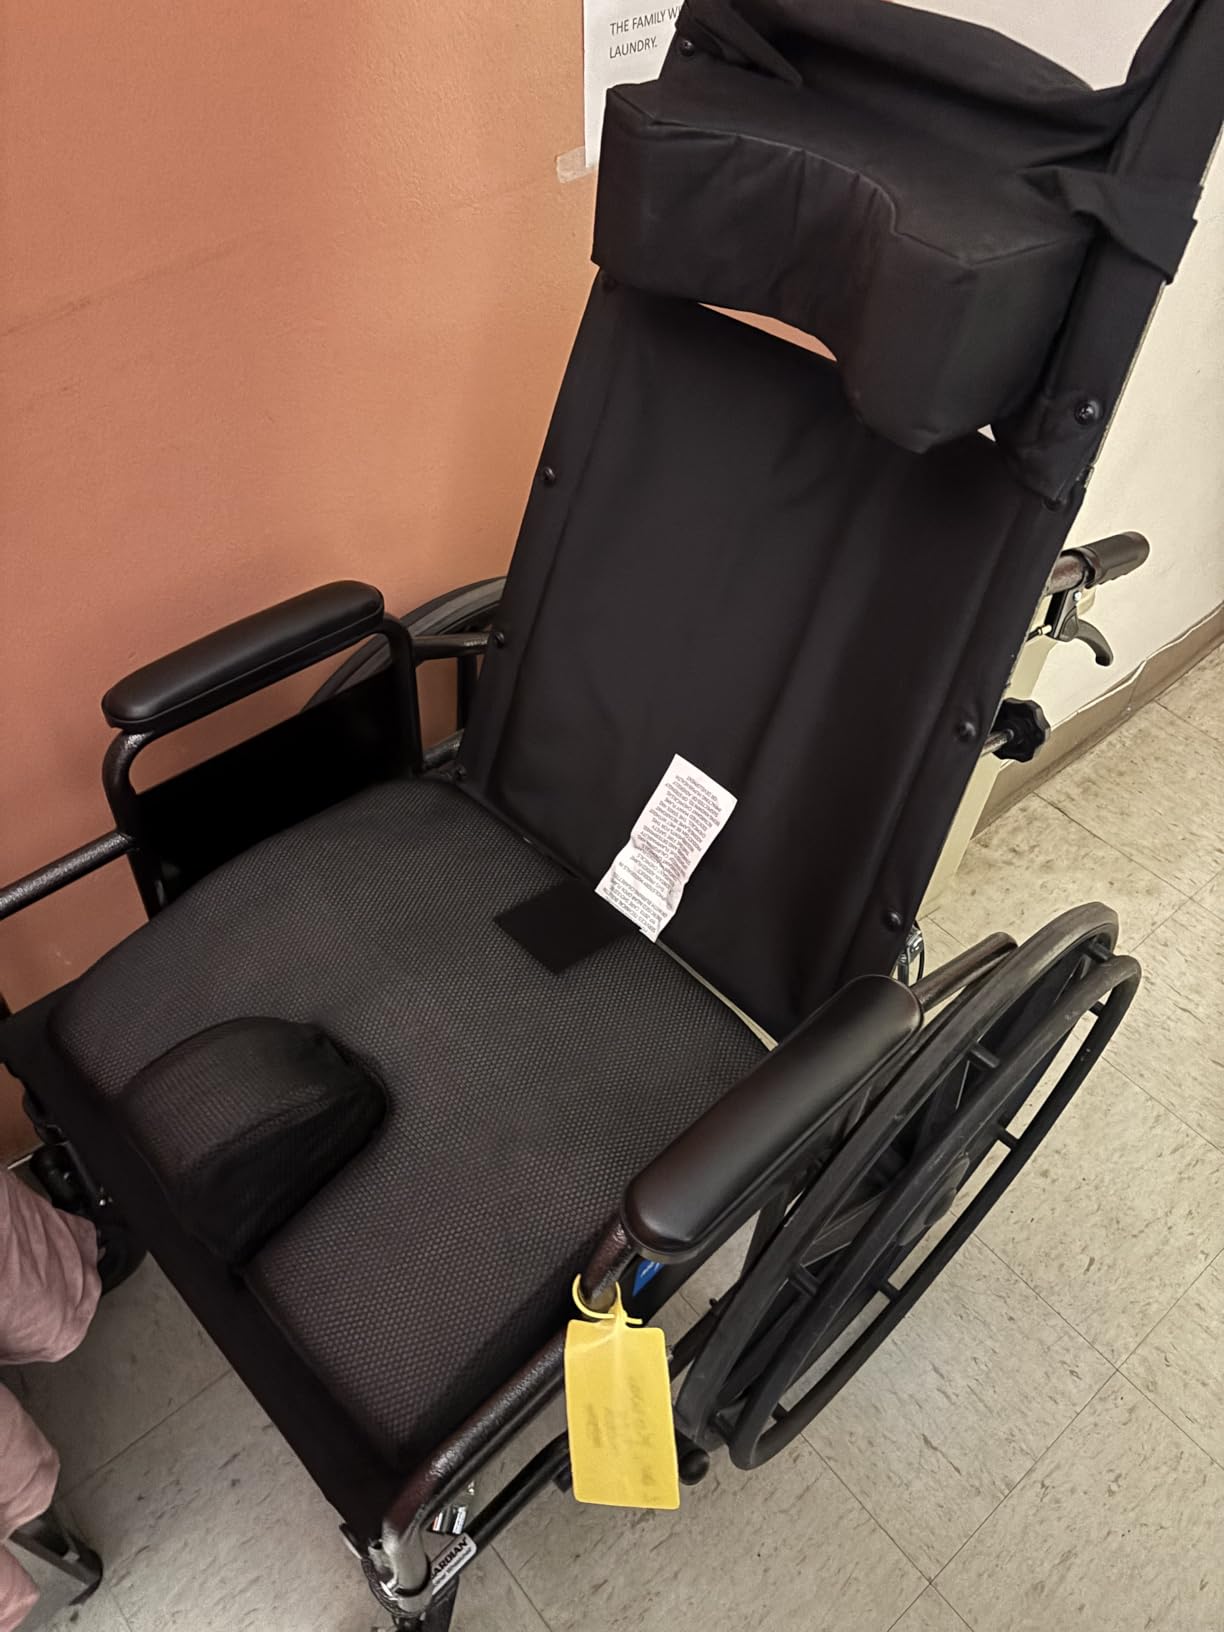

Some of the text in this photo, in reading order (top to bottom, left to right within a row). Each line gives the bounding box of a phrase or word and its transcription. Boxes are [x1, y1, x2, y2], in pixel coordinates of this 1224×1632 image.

[610, 19, 629, 36] THE
[632, 9, 666, 30] FAMILY
[609, 36, 658, 59] LAUNDRY.
[431, 1537, 467, 1579] ARDIAN
